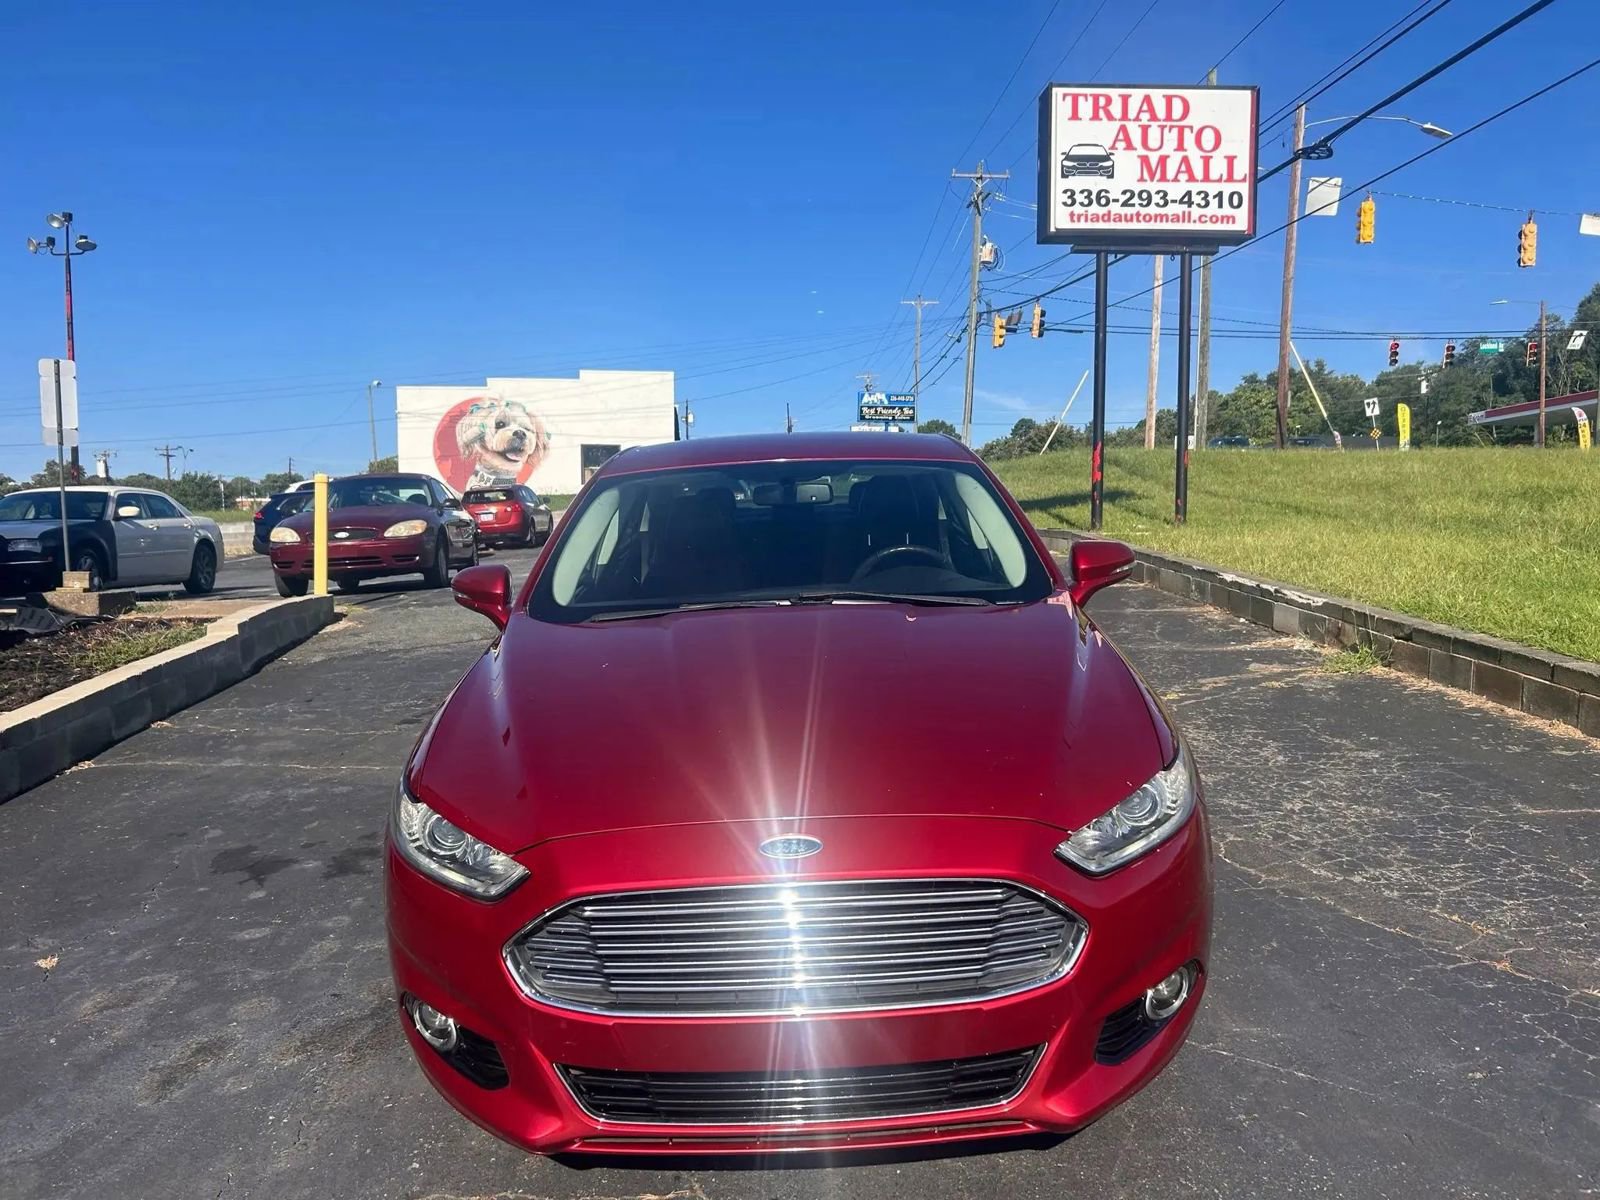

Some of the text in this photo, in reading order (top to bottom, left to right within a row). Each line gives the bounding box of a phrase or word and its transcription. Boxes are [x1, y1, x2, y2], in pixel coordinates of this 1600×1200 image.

[1062, 92, 1191, 122] TRIAD
[1108, 124, 1222, 153] AUTO
[1136, 154, 1248, 183] MALL
[1061, 188, 1244, 209] 336-293-4310
[1068, 209, 1237, 225] triadautomall.com
